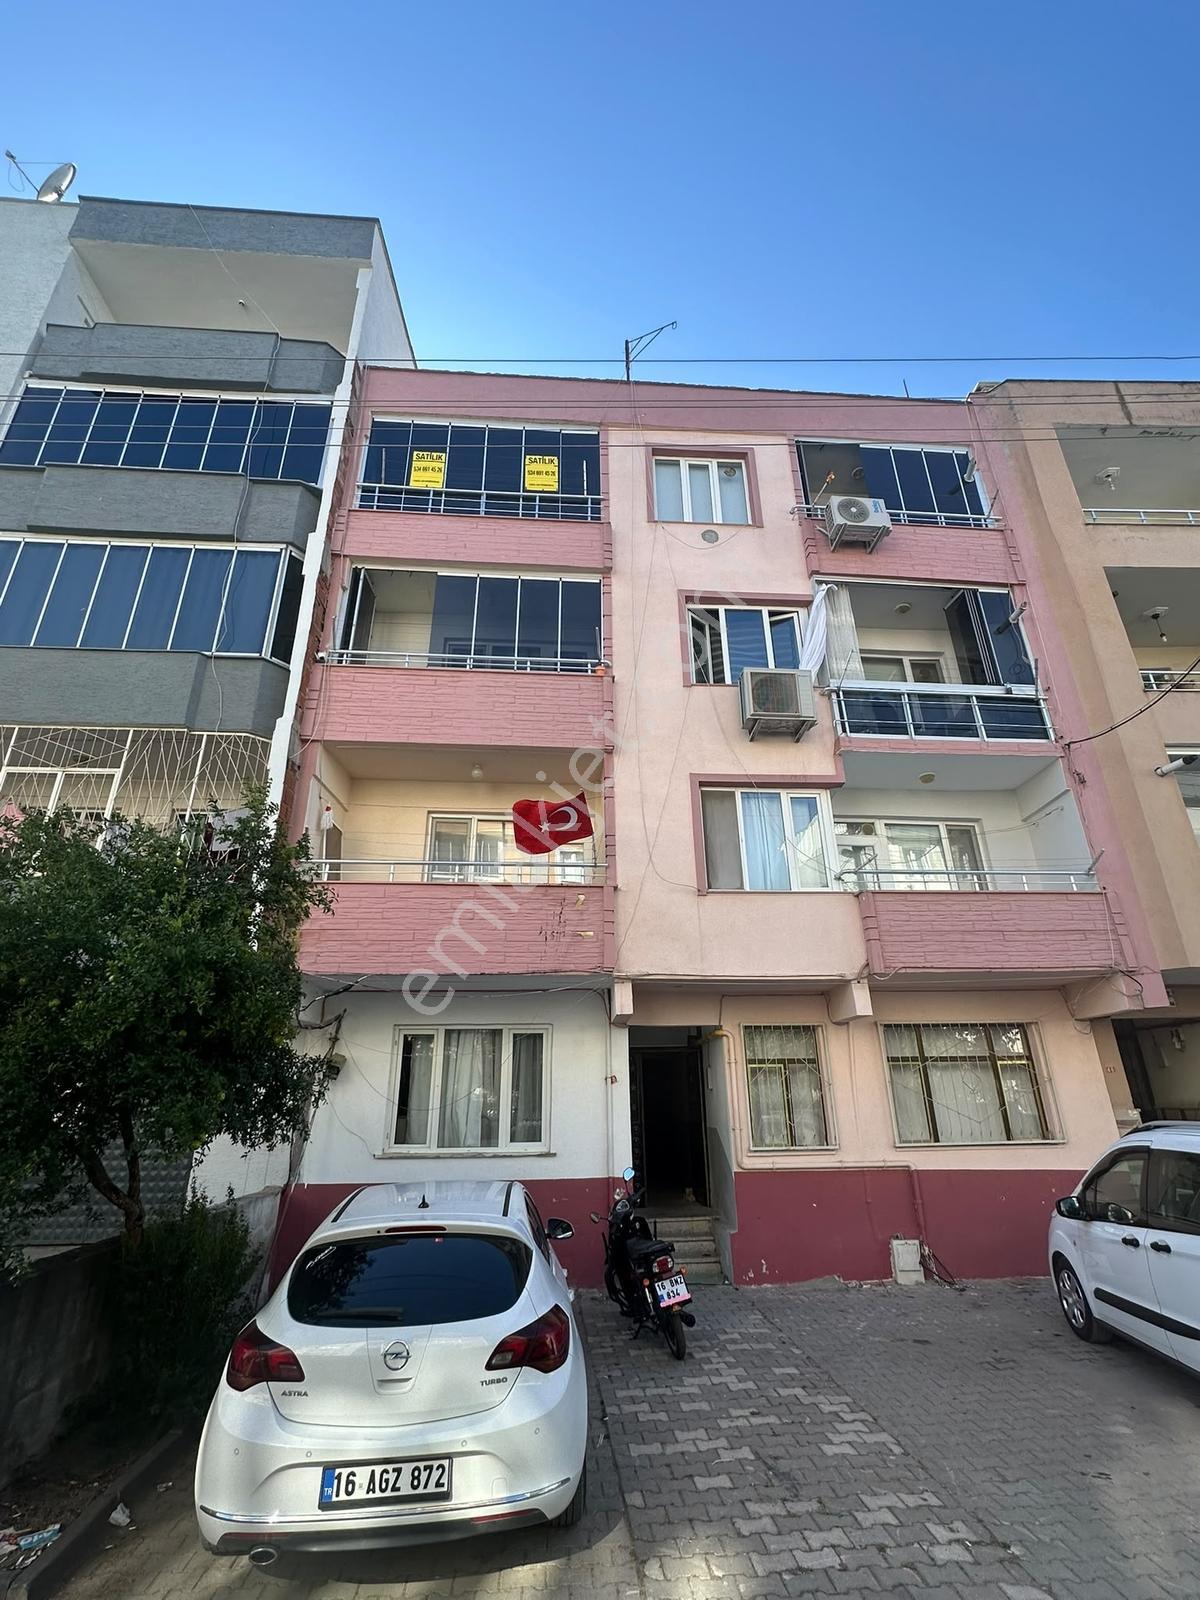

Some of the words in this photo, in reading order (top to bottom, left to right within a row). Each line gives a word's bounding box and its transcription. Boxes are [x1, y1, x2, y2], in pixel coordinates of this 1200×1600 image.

[657, 1282, 666, 1292] 16
[480, 1377, 508, 1387] TURBO
[324, 1487, 333, 1496] TR
[334, 1470, 357, 1498] 16
[365, 1466, 402, 1495] AGZ
[410, 1463, 446, 1491] 872
